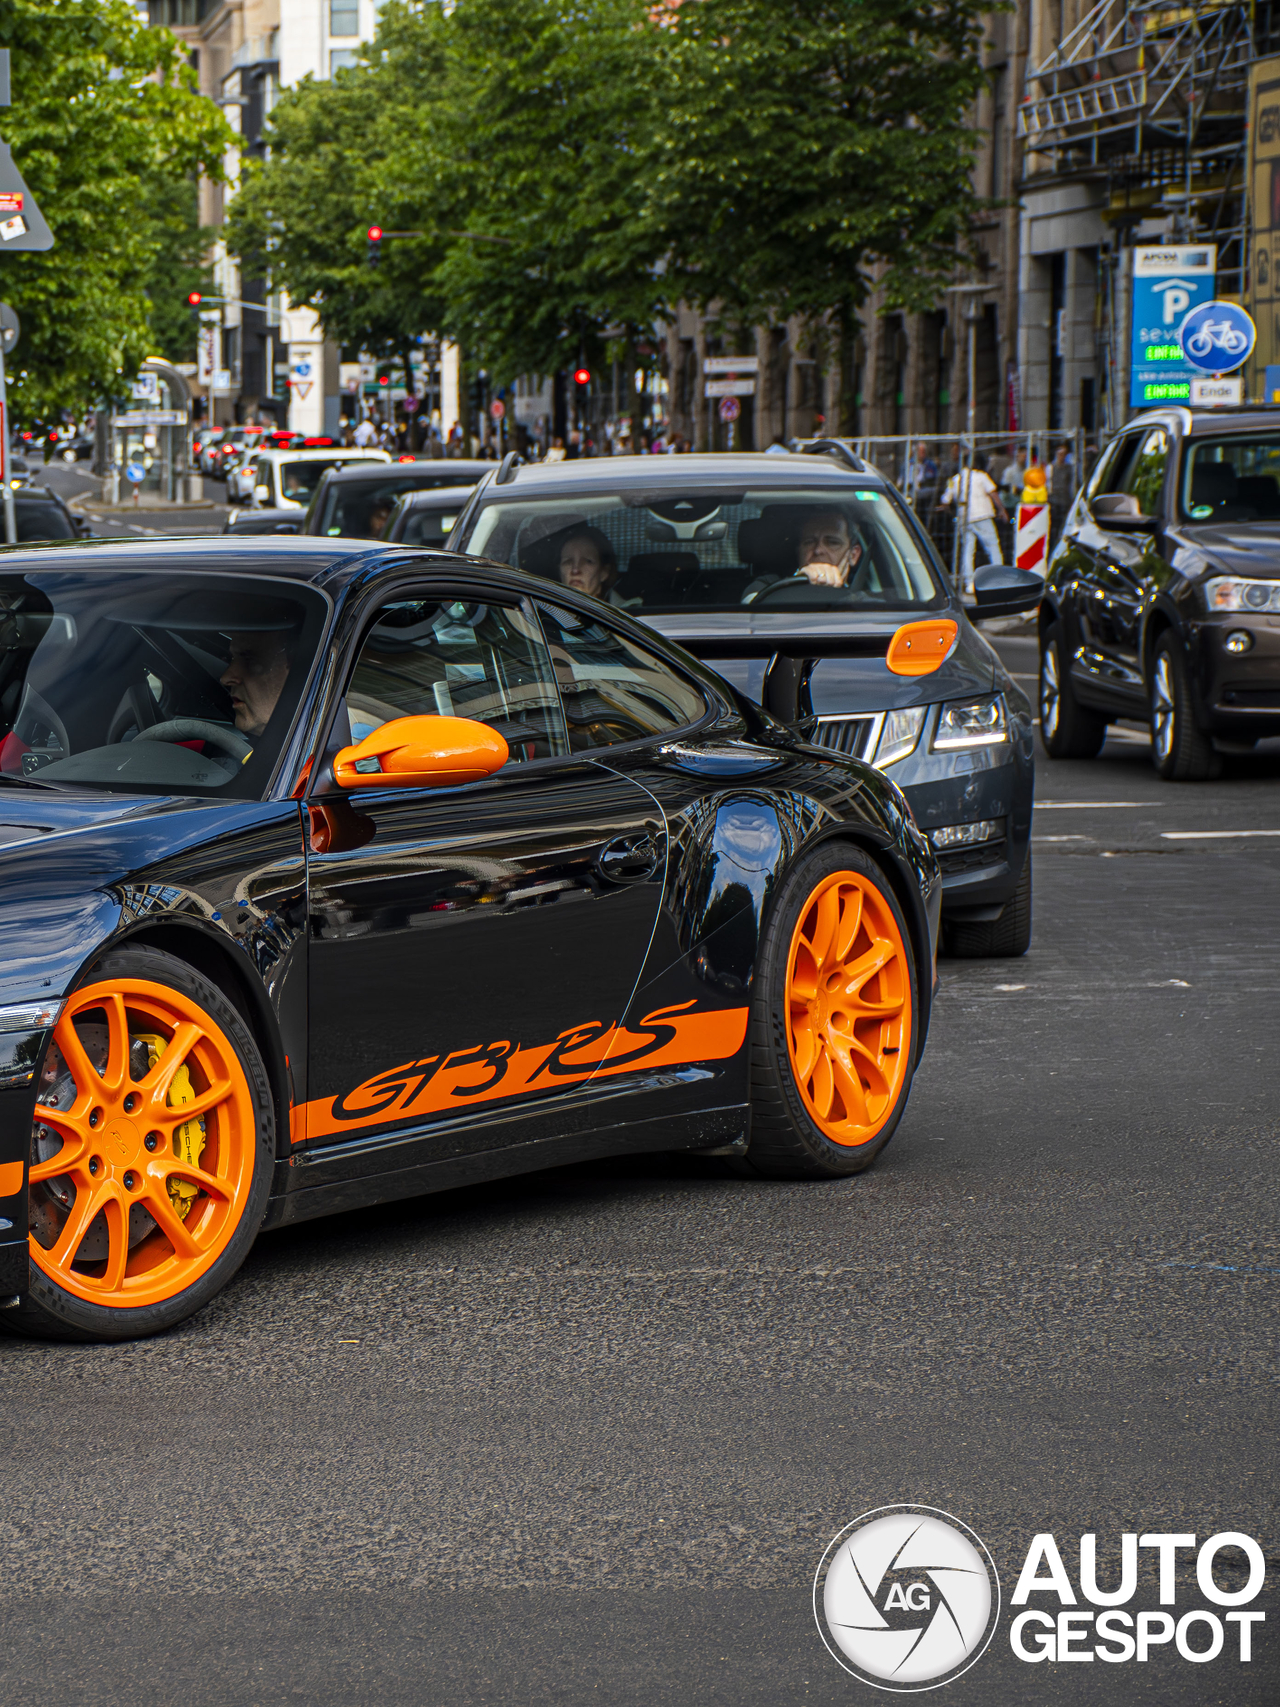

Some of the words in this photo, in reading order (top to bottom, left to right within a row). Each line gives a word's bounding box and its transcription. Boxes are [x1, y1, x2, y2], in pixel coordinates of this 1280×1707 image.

[1163, 288, 1190, 325] P
[1199, 386, 1232, 397] Ende
[331, 1041, 520, 1121] GT3
[526, 1000, 699, 1083] RS
[181, 1096, 193, 1165] PRSCHE
